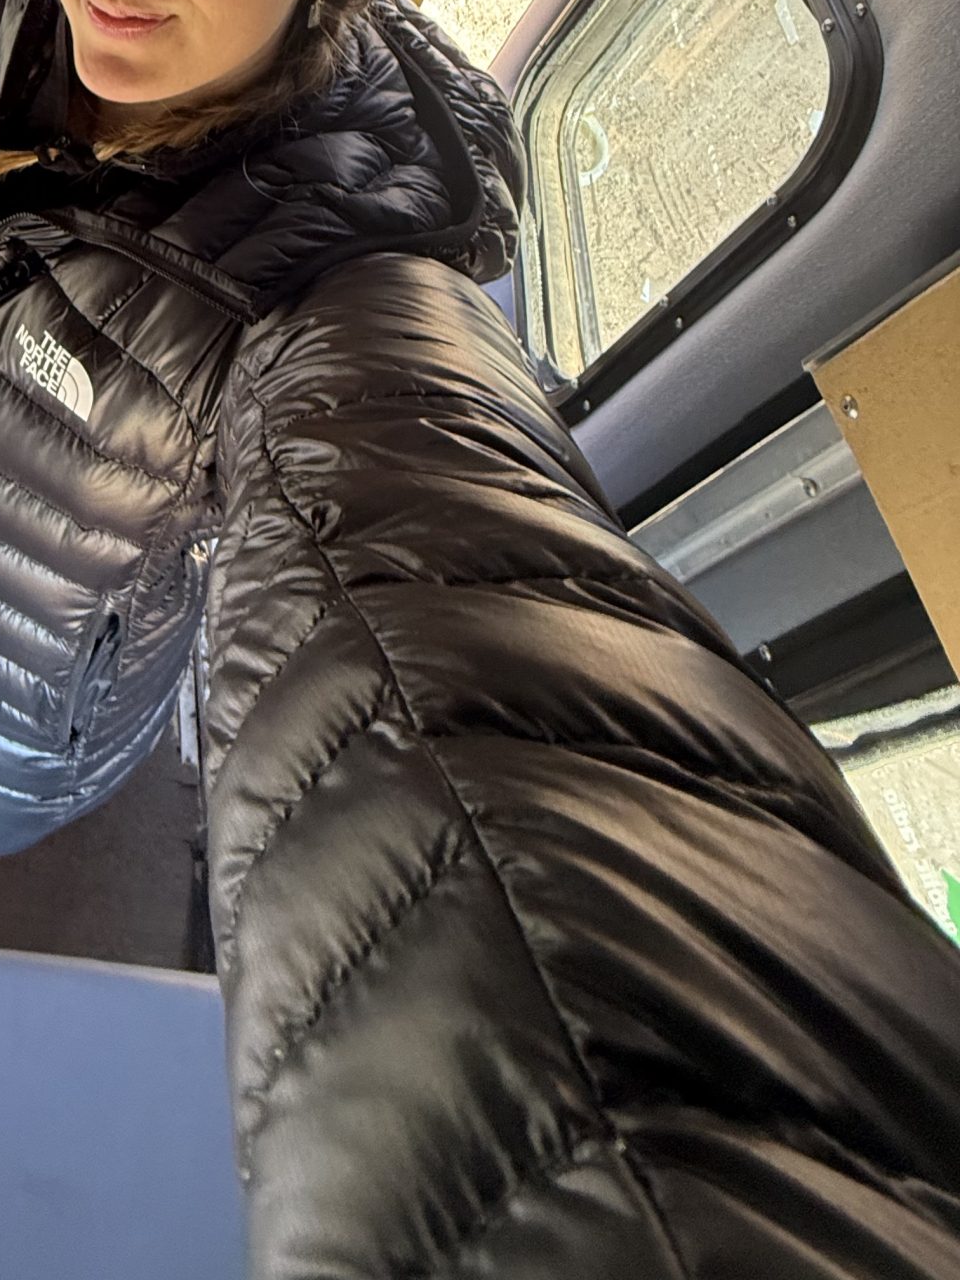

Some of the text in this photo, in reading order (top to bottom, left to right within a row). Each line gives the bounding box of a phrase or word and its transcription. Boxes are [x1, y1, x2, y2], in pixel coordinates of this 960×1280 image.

[15, 323, 66, 386] NORTH
[41, 330, 72, 370] THE
[20, 352, 60, 398] FACE
